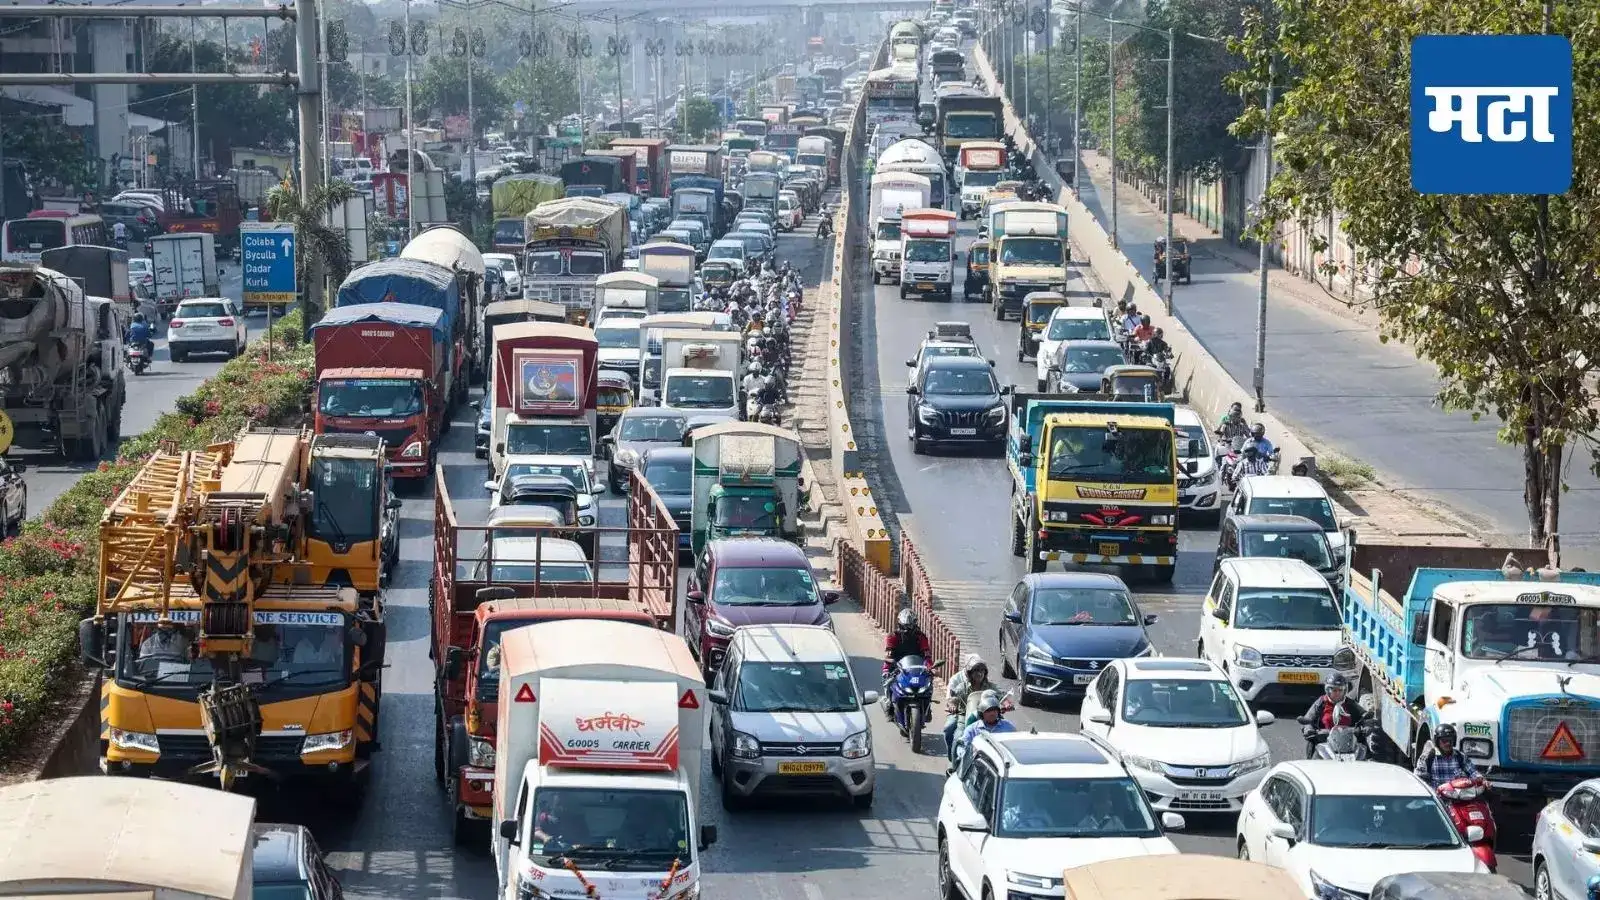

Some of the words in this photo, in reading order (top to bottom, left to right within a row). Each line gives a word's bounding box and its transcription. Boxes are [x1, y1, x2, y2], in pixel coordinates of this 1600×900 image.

[245, 237, 275, 246] Colaba
[245, 250, 276, 261] Byculla
[246, 263, 271, 273] Dadar
[246, 277, 269, 287] Kurla
[1078, 486, 1112, 498] GOODS
[1112, 489, 1146, 500] CARRIER
[1520, 595, 1541, 604] GOODS
[1548, 594, 1573, 605] CARRIER
[279, 613, 338, 624] SERVICE
[575, 711, 646, 732] धर्मवीर
[567, 739, 600, 748] GOODS
[613, 741, 651, 751] CARRIER
